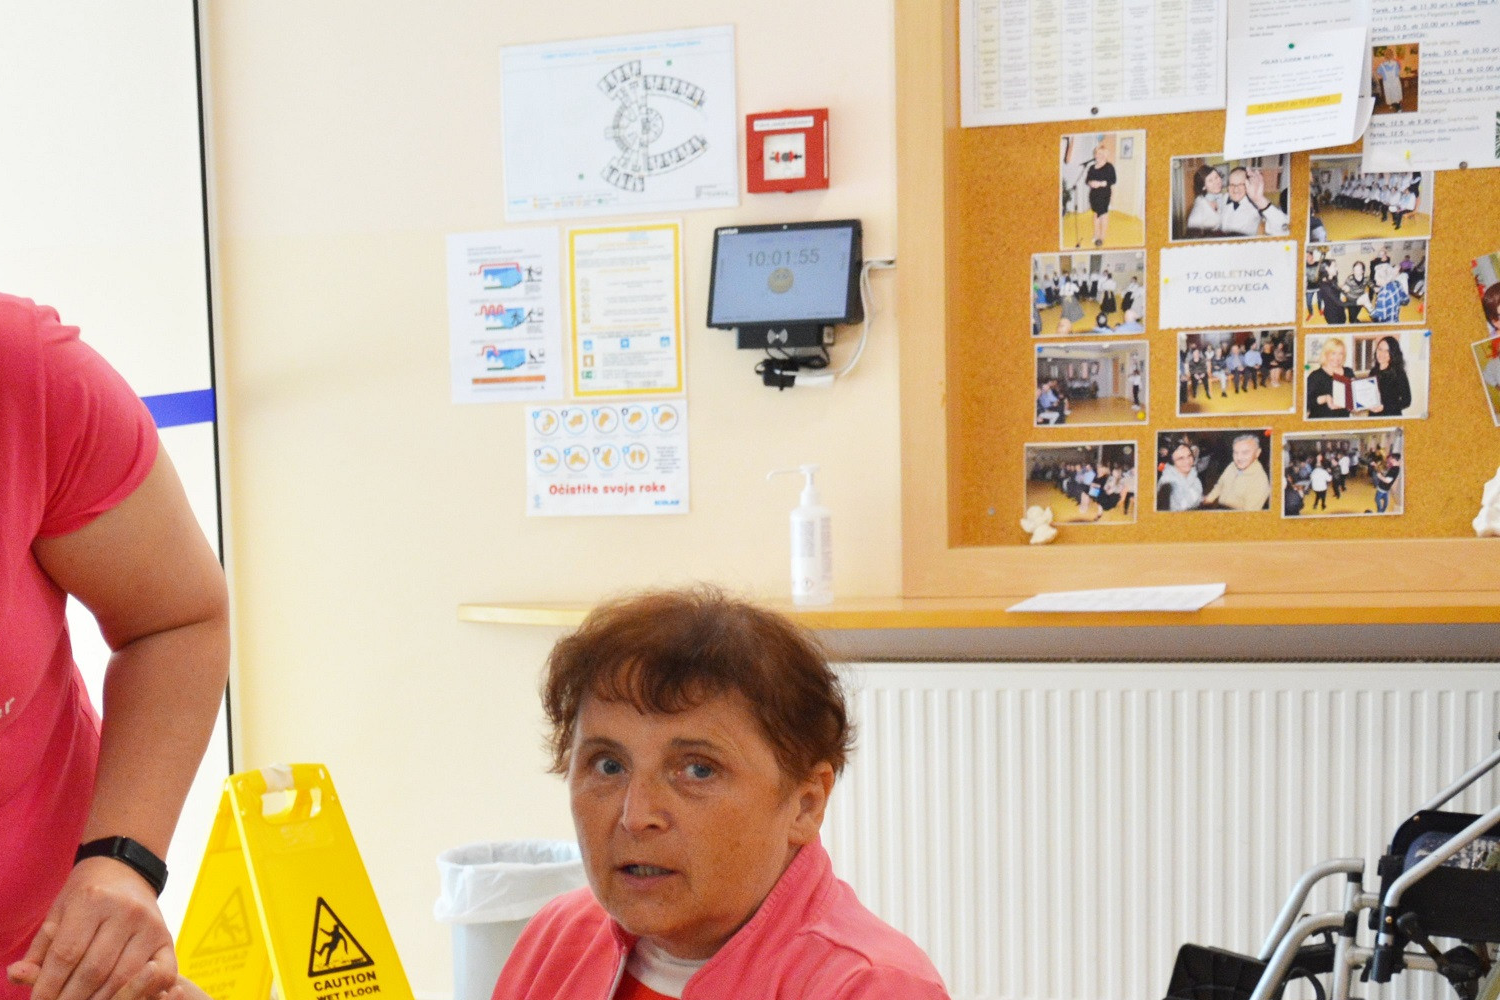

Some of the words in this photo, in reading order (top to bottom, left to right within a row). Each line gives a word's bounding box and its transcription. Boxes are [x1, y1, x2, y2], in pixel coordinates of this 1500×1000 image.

[748, 248, 820, 267] 10:01:55
[1204, 268, 1274, 280] OBLETNICA
[1187, 282, 1270, 294] PEGAZOVEGA
[1210, 296, 1246, 306] DOMA
[549, 483, 599, 495] Očistite
[602, 484, 635, 496] svoje
[639, 482, 666, 493] roke
[313, 970, 377, 992] CAUTION
[344, 985, 381, 999] FLOOR
